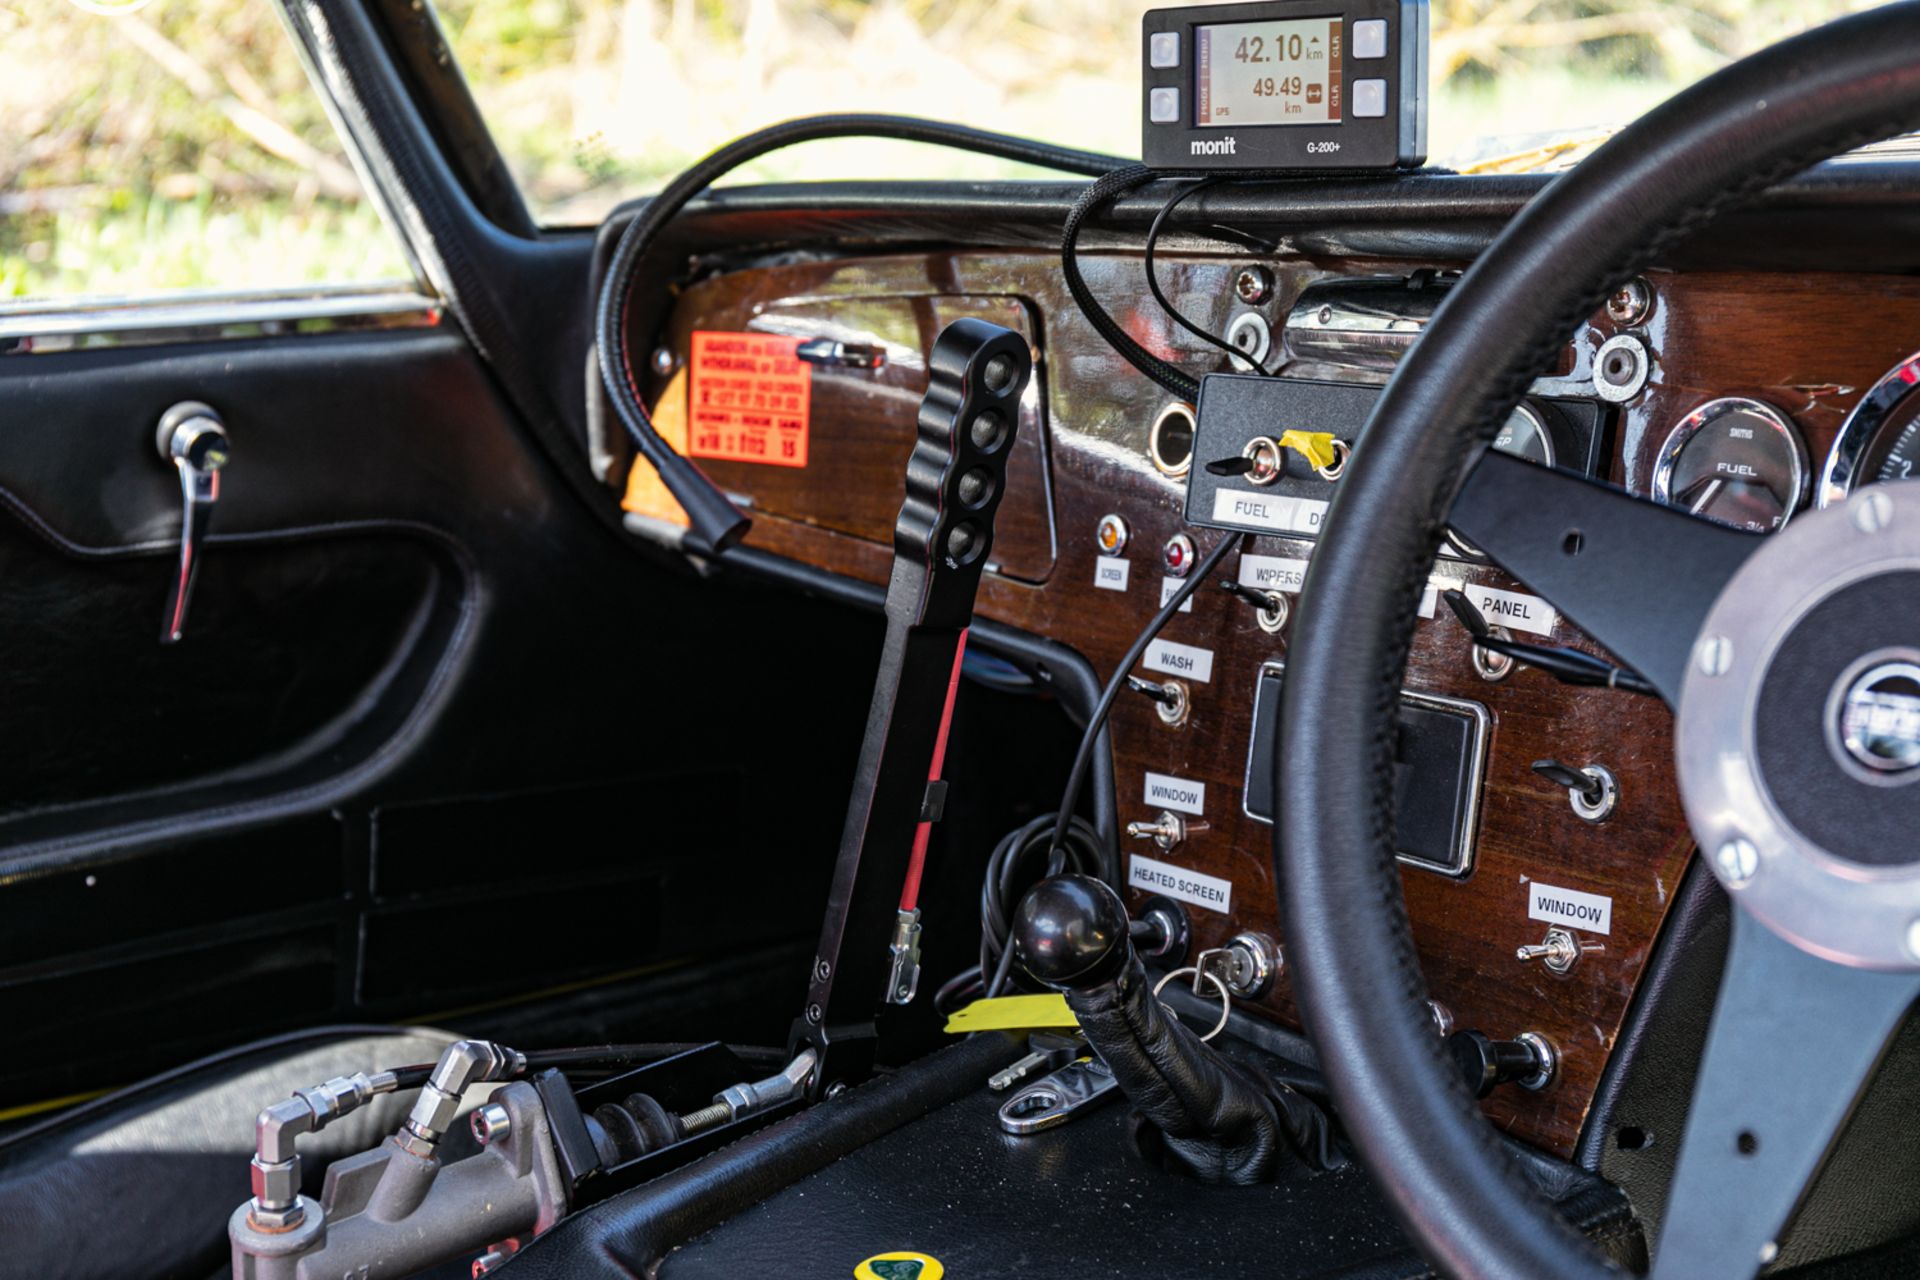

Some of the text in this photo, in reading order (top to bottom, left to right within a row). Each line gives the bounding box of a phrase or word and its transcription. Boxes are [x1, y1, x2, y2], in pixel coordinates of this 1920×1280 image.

[1235, 34, 1323, 63] 42.10 km
[1253, 76, 1302, 97] 49.49
[1201, 87, 1209, 115] MODE
[1285, 101, 1302, 114] km
[1191, 136, 1236, 155] monit
[1307, 142, 1341, 153] G-200+
[1717, 462, 1757, 477] FUEL
[1234, 501, 1269, 519] FUEL
[1256, 567, 1302, 585] WIPERS
[1482, 597, 1531, 620] PANEL
[1161, 652, 1194, 671] WASH
[1151, 784, 1198, 805] WINDOW
[1133, 867, 1225, 903] HEATED SCREEN
[1537, 896, 1602, 923] WINDOW
